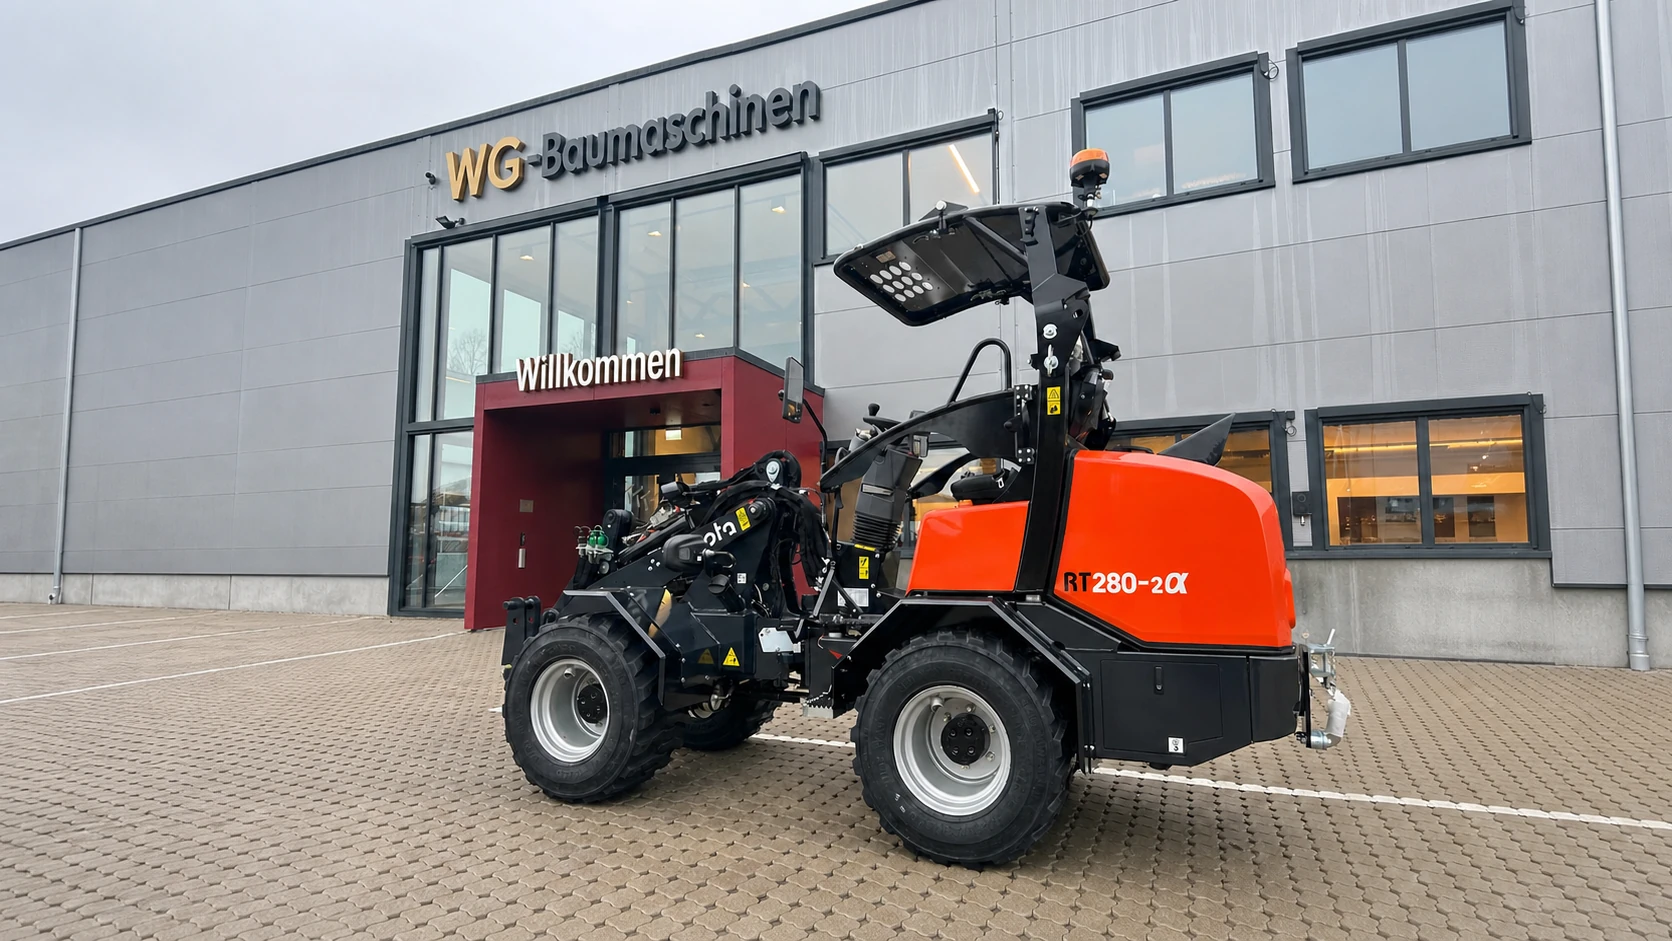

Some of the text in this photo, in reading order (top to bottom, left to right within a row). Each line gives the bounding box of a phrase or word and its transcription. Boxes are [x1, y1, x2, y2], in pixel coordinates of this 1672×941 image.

[446, 80, 821, 200] WG-Baumaschinen
[516, 347, 682, 391] Willkommen
[703, 521, 737, 547] ota
